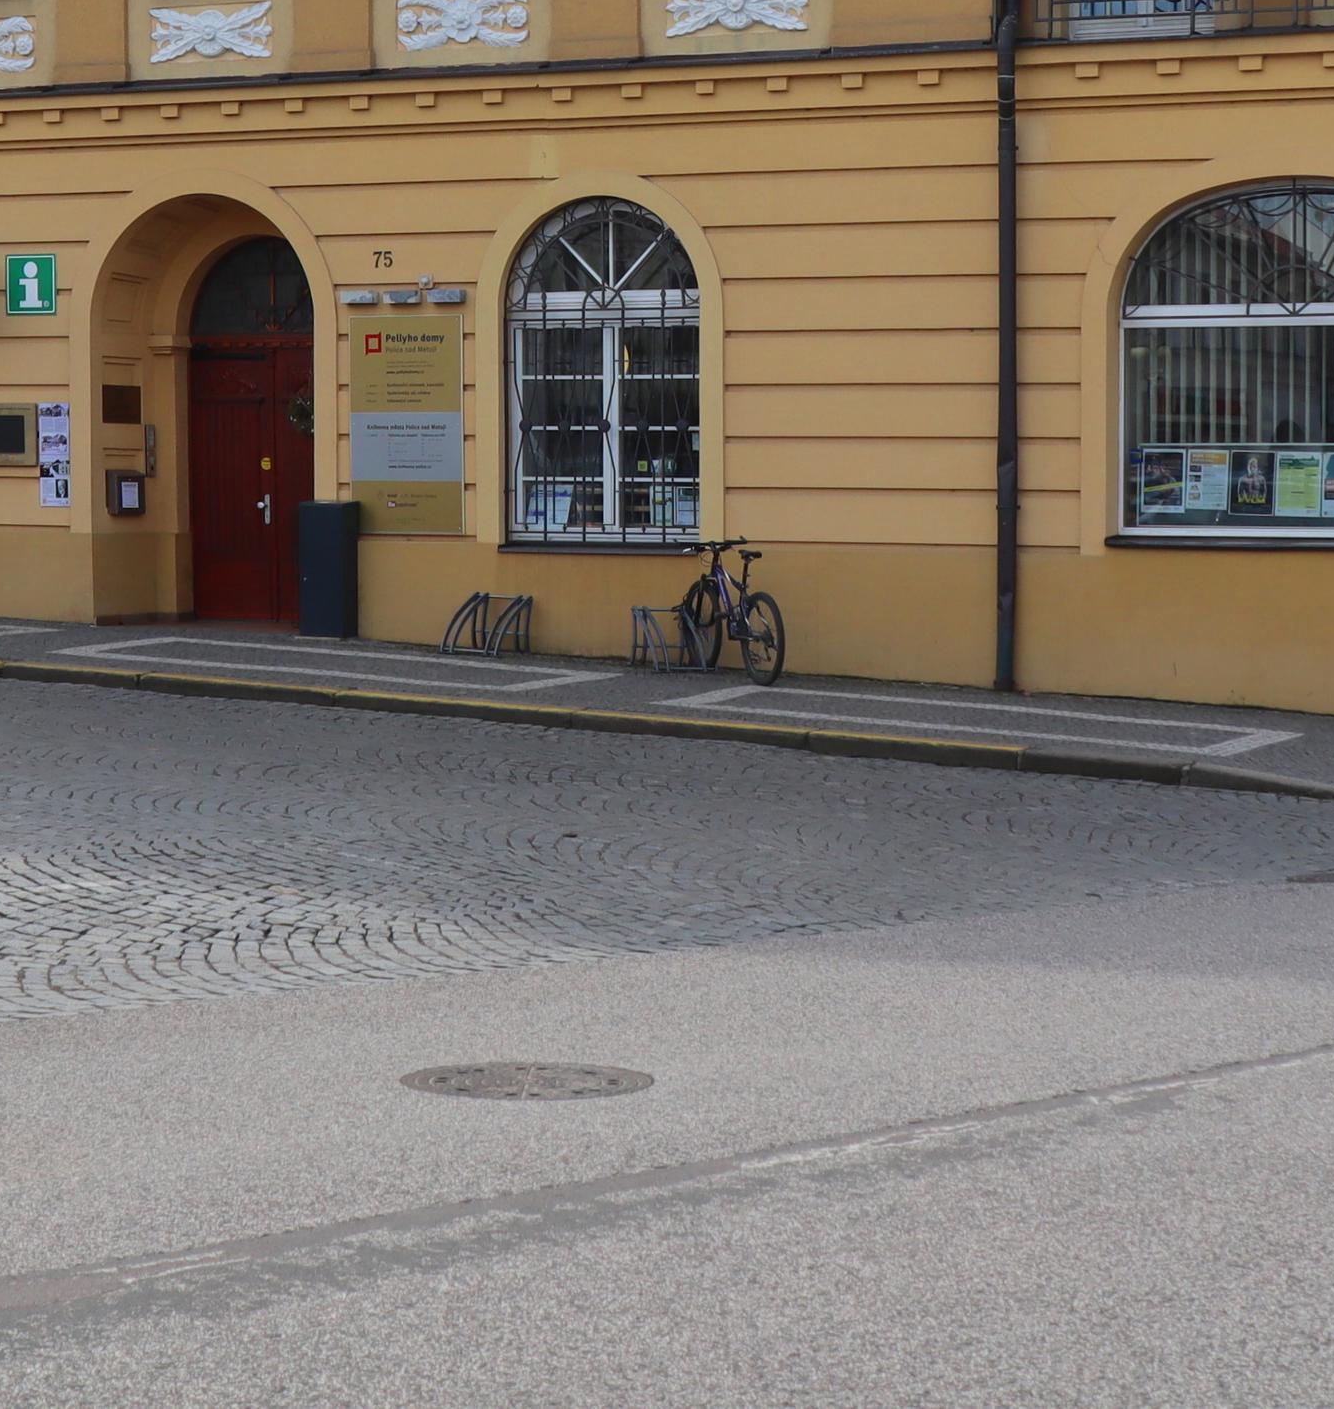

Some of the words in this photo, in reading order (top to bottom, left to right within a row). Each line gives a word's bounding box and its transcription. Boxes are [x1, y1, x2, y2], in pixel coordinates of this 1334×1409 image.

[372, 250, 394, 269] 75
[385, 333, 419, 344] Pellyho
[420, 333, 445, 344] domy
